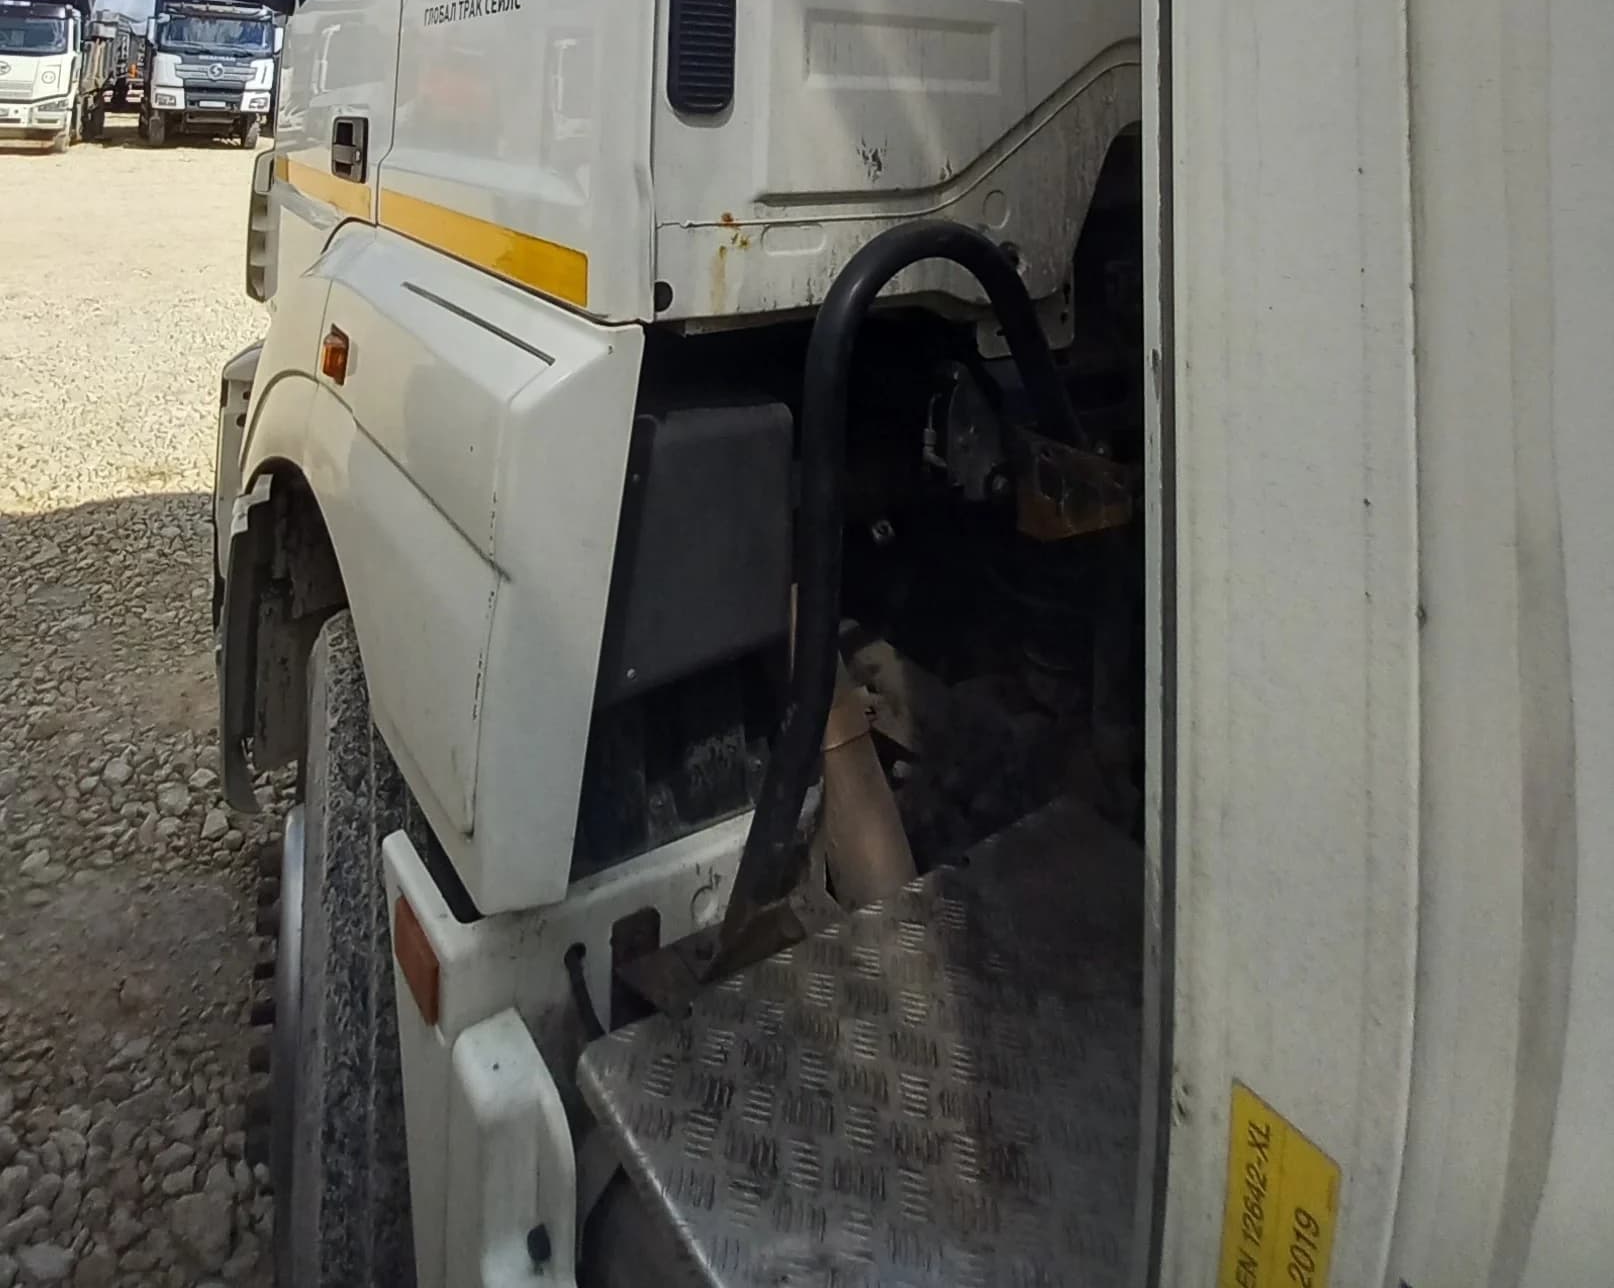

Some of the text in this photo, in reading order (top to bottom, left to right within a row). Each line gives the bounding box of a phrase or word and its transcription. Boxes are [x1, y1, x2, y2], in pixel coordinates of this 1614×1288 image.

[424, 2, 457, 27] ГЛОБАЛ
[1235, 1120, 1271, 1288] EN 12642-XL
[1287, 1207, 1320, 1288] 2019
